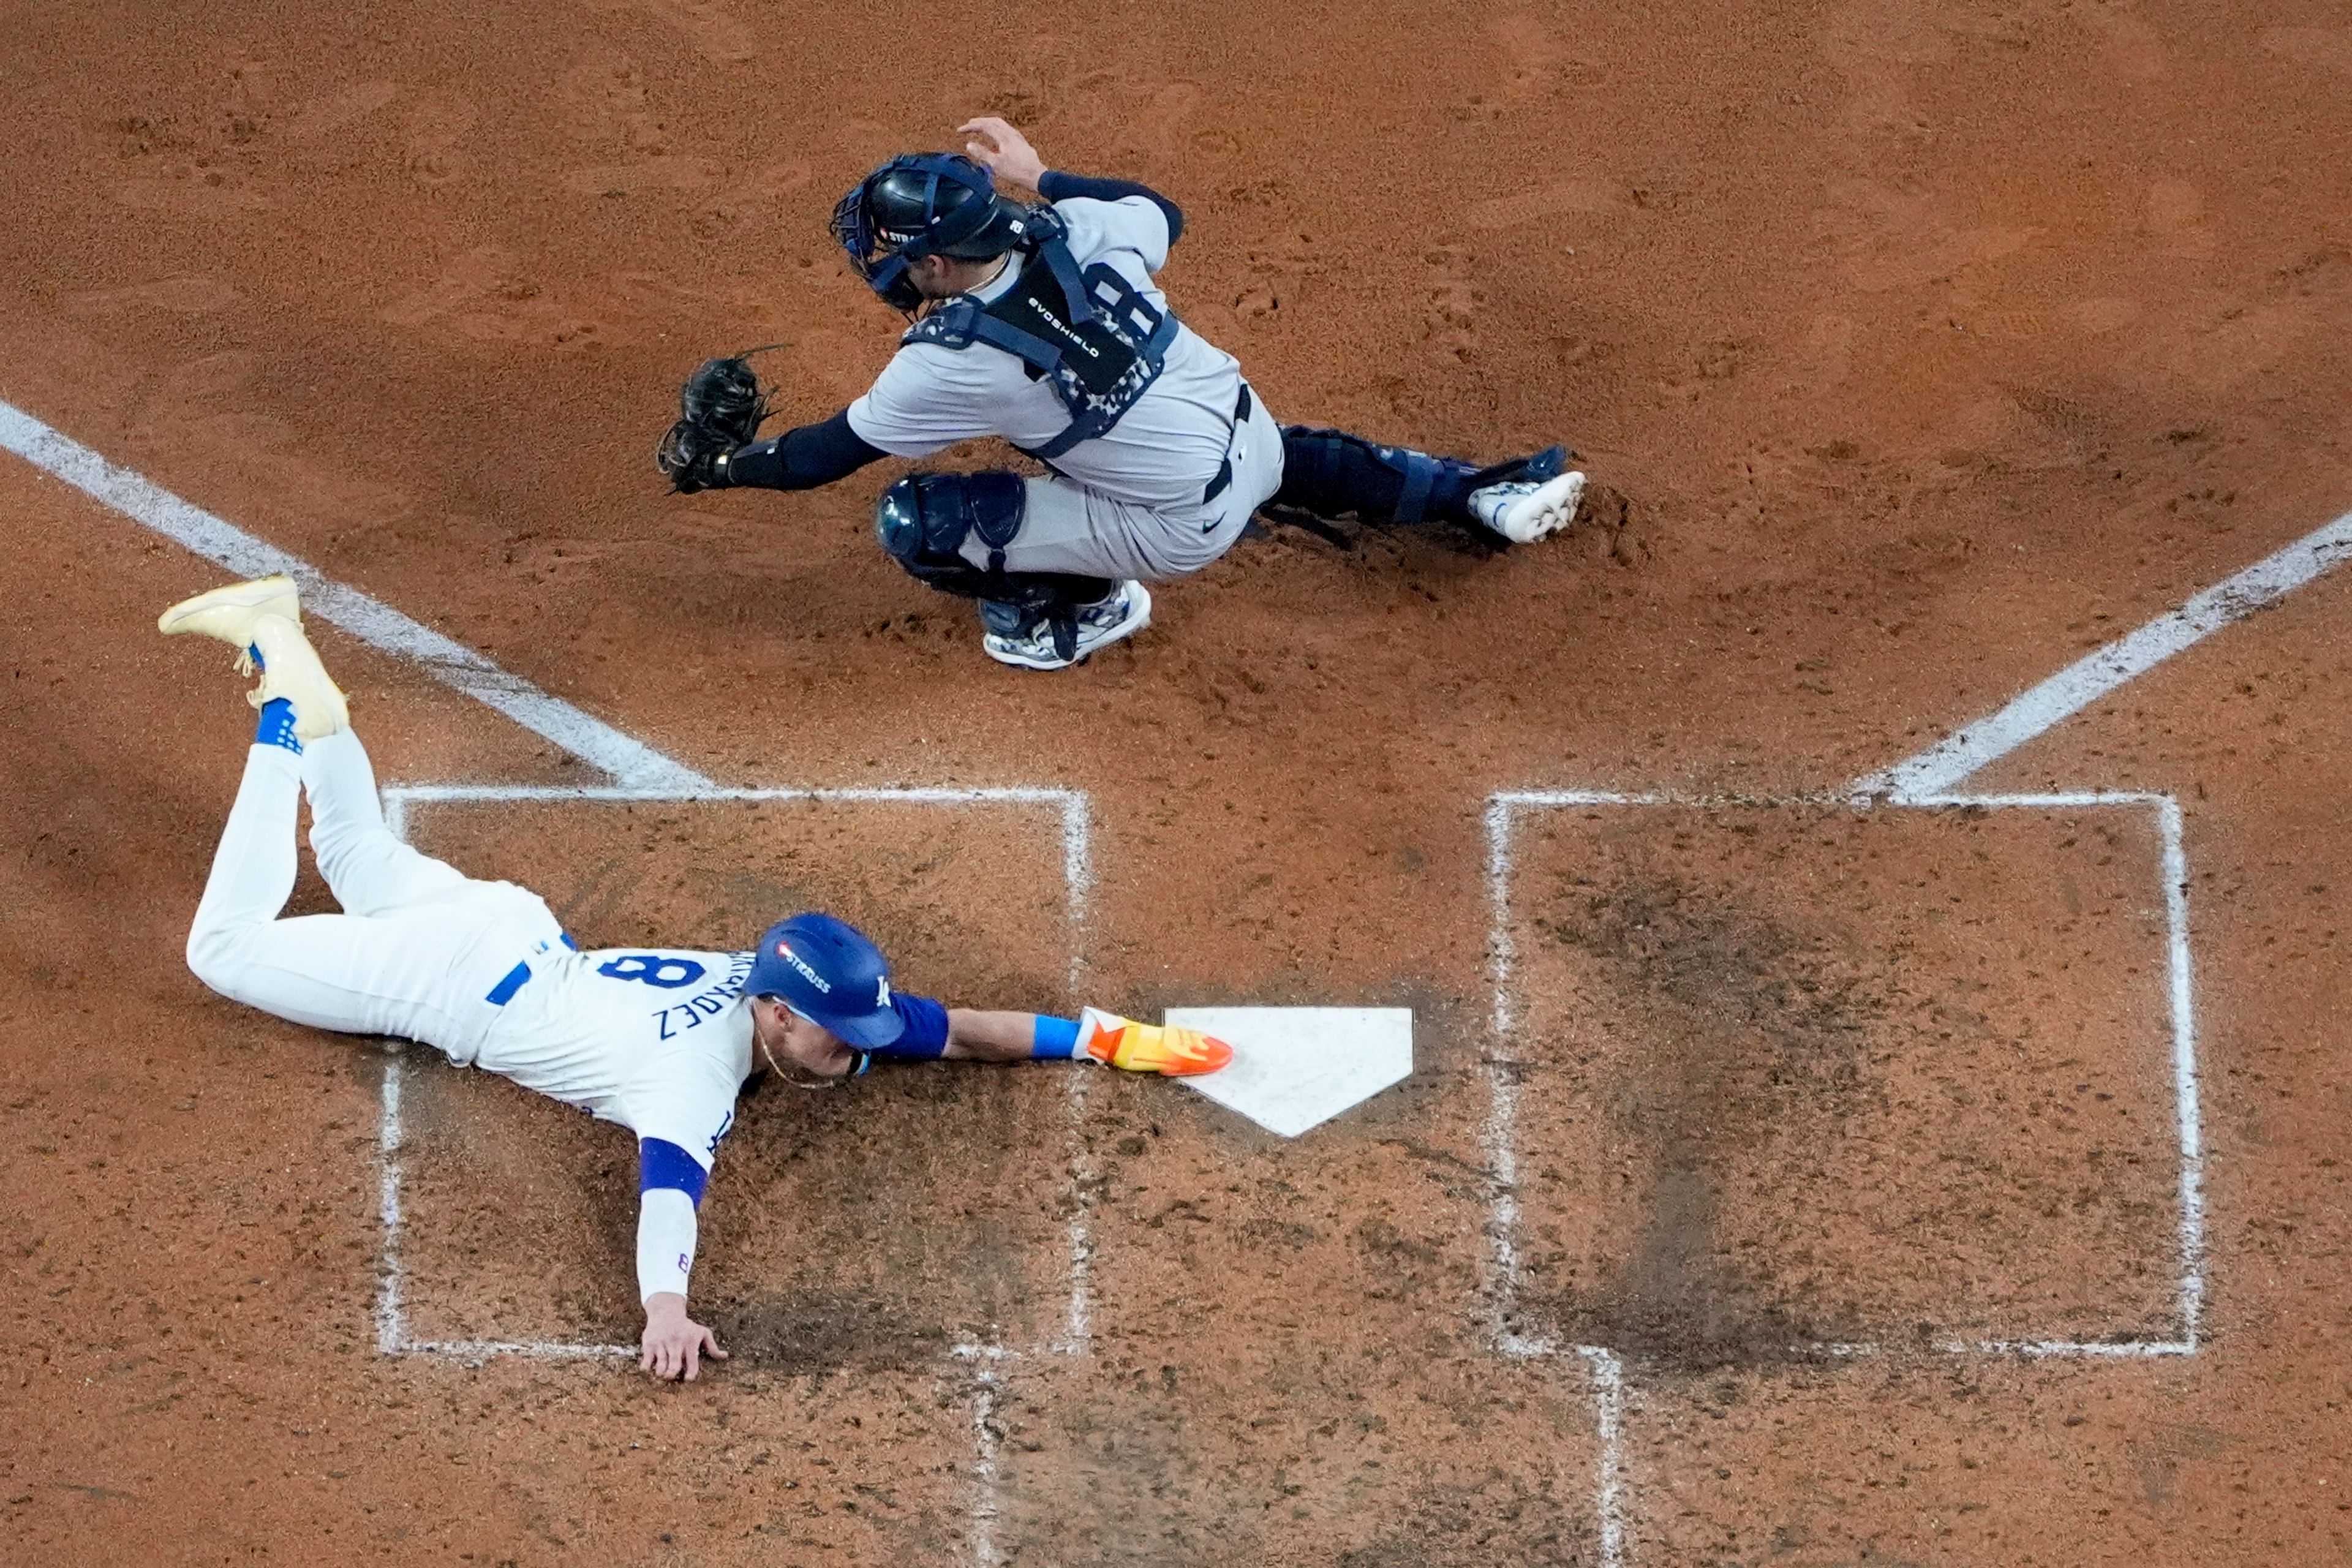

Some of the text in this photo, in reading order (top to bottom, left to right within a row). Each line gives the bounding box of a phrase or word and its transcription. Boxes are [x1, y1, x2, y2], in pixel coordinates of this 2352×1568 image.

[1028, 297, 1099, 358] EVOSHIELD
[597, 956, 706, 989] 8
[786, 951, 831, 993] STRAUSS
